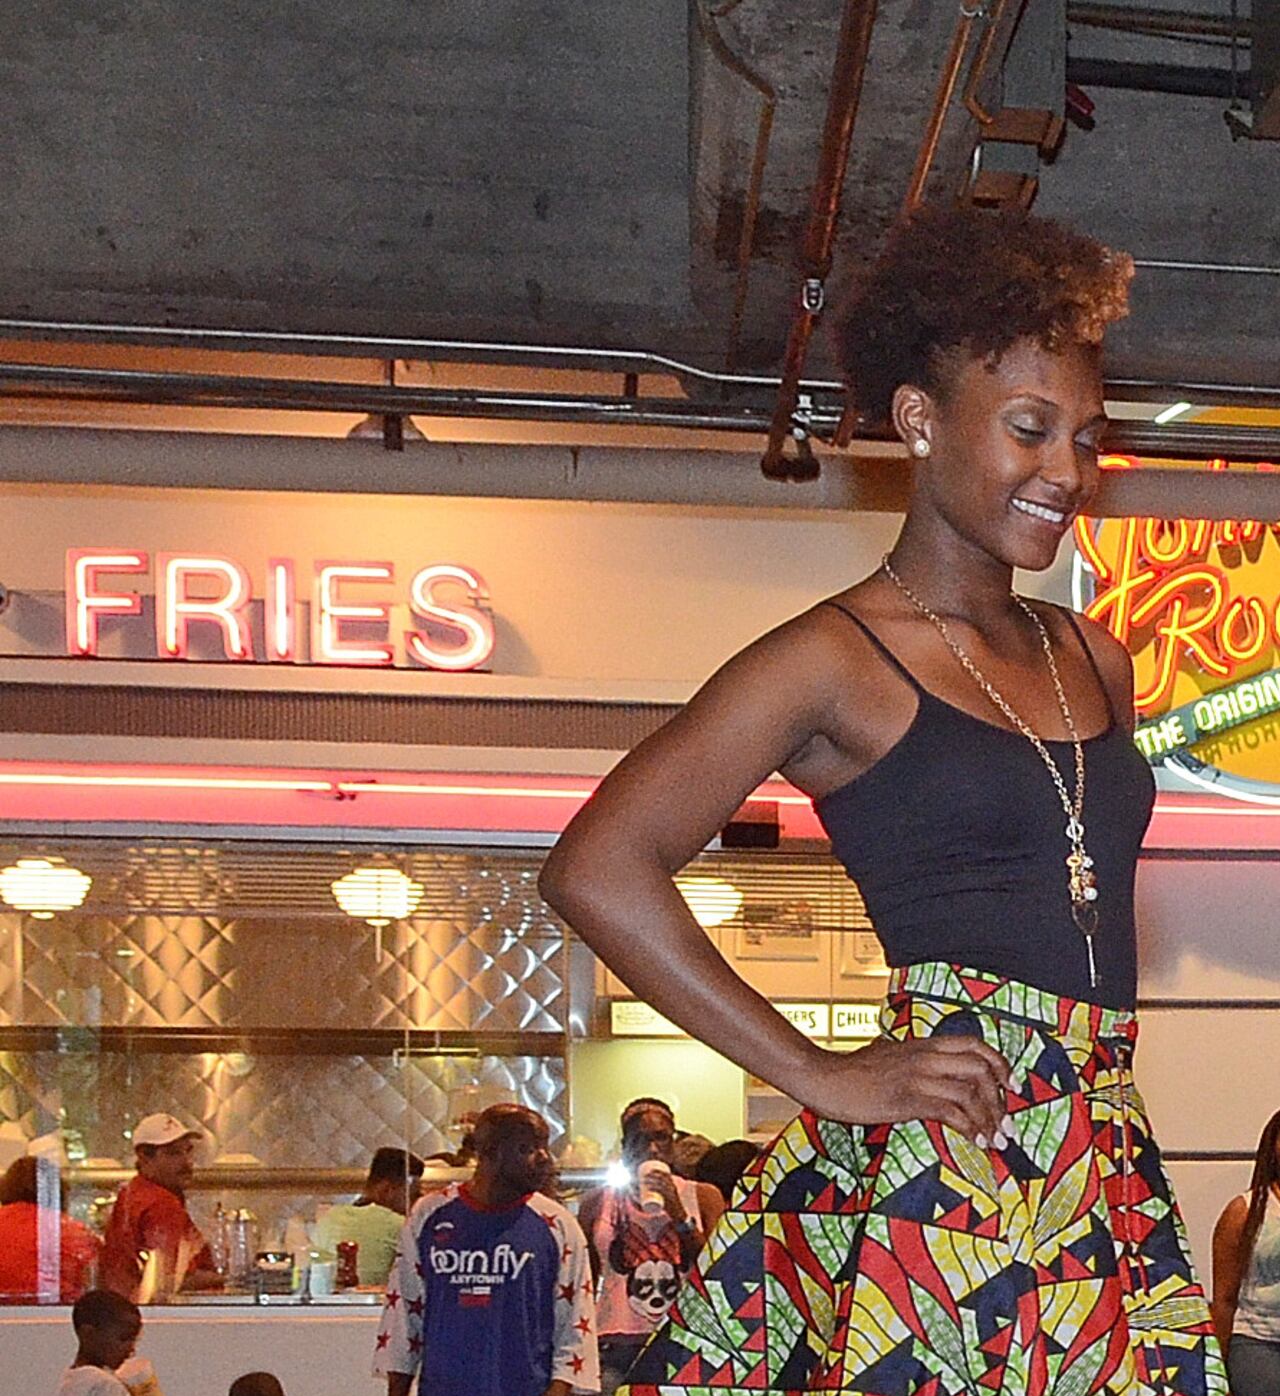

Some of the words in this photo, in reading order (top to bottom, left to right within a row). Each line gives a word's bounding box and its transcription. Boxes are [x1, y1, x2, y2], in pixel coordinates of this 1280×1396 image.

[66, 548, 496, 671] FRIES
[1134, 715, 1188, 757] THE
[430, 1246, 489, 1274] born
[491, 1243, 531, 1280] fly
